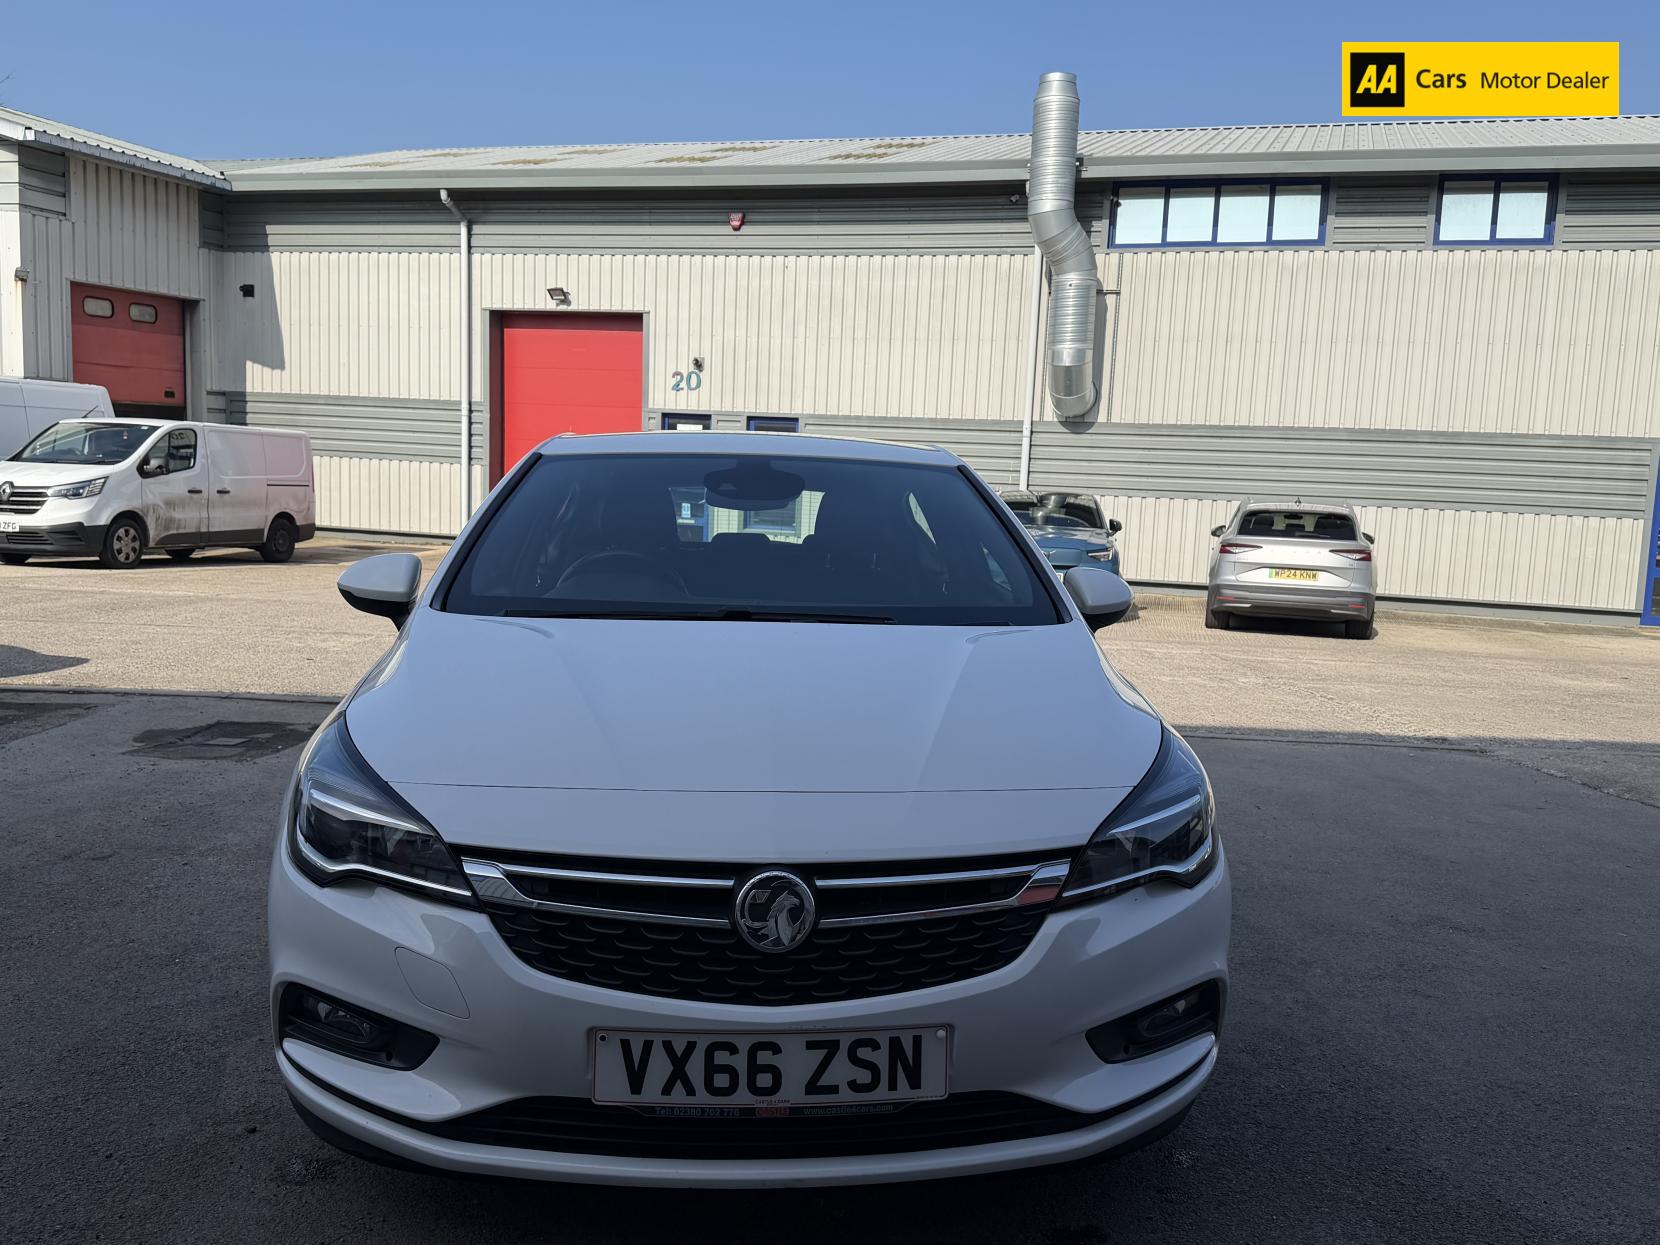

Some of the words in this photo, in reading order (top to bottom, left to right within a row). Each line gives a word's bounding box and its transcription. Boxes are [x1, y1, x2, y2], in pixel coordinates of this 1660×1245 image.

[671, 370, 702, 392] 20
[2, 521, 17, 530] ZFG
[1274, 567, 1298, 579] WP24
[1299, 569, 1317, 580] KNW
[620, 1038, 782, 1097] VX66
[804, 1034, 922, 1096] ZSN
